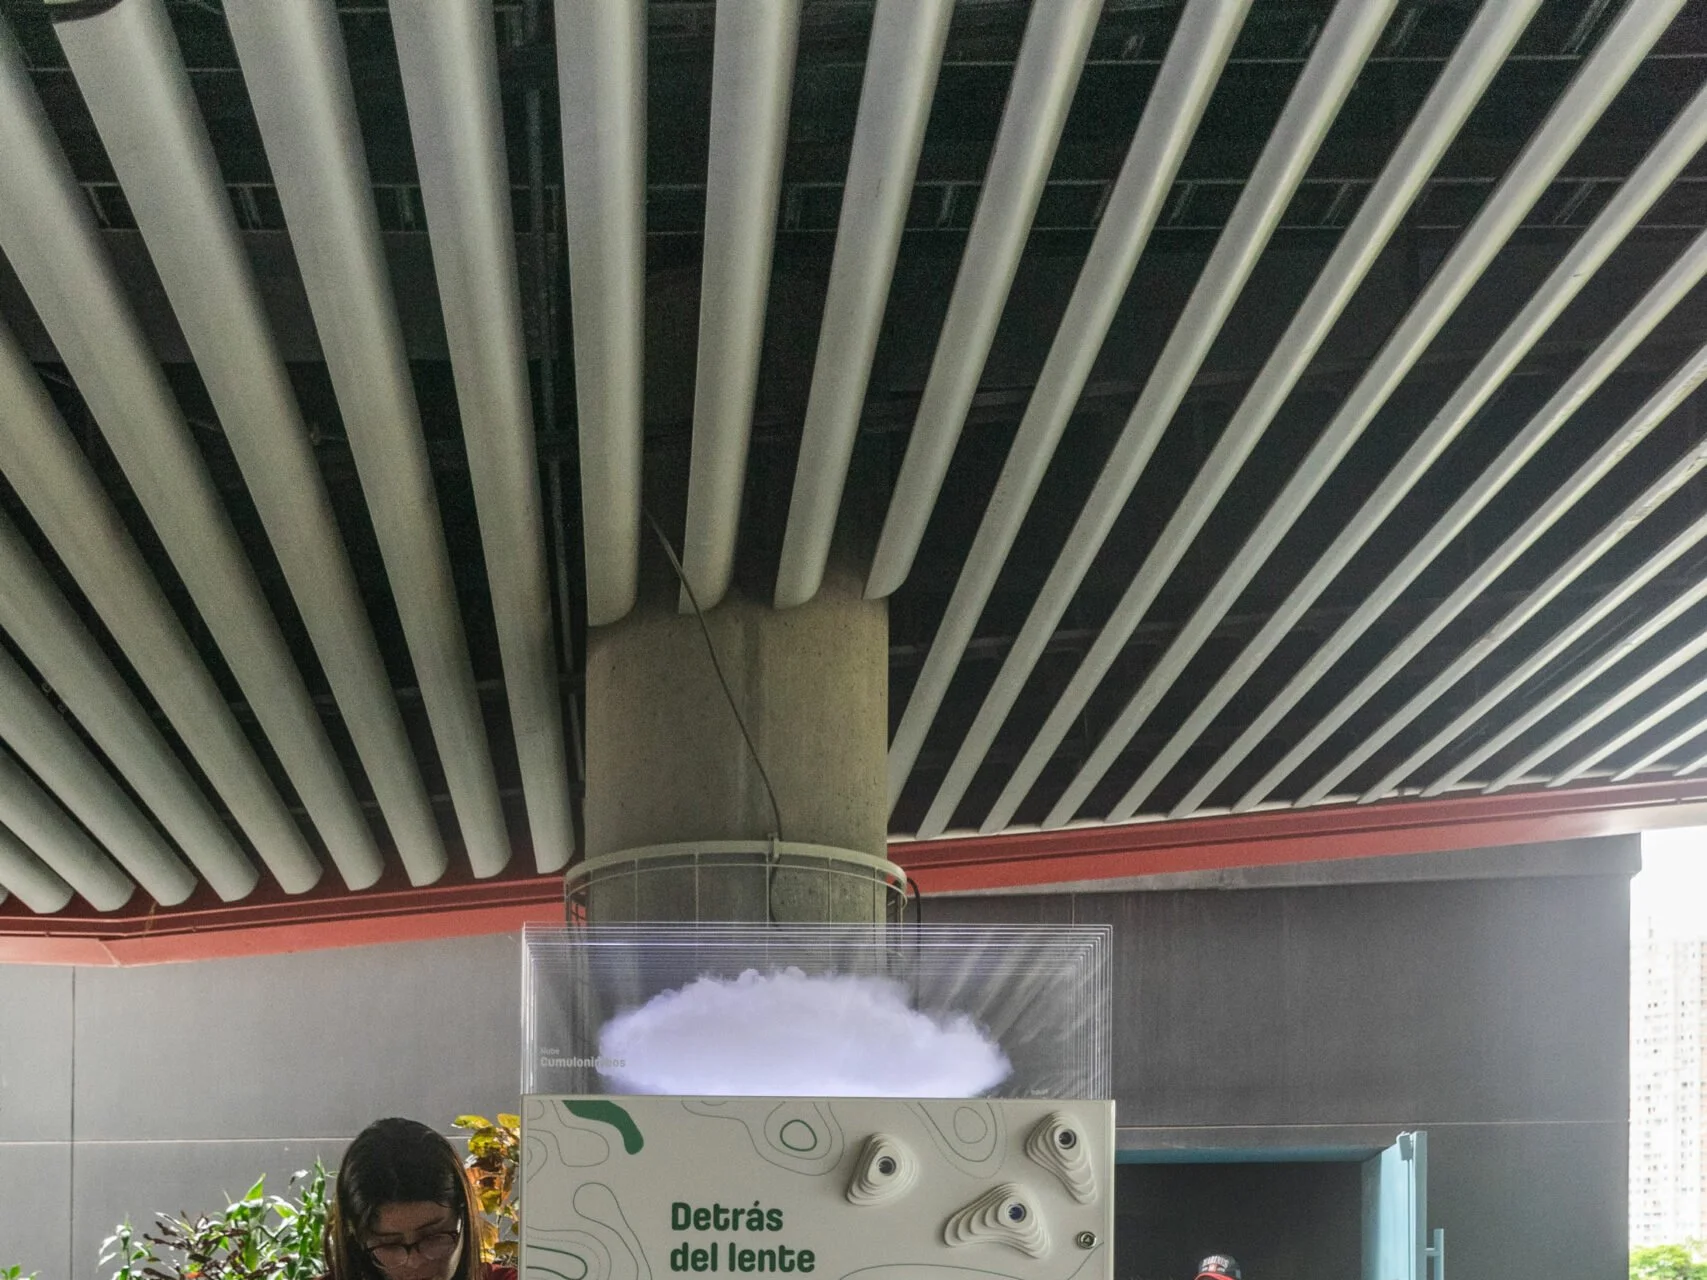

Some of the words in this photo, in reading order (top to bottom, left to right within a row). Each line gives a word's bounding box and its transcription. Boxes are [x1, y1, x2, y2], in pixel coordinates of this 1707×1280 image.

[672, 1200, 783, 1232] Detrás
[670, 1242, 718, 1272] del
[728, 1242, 816, 1272] lente
